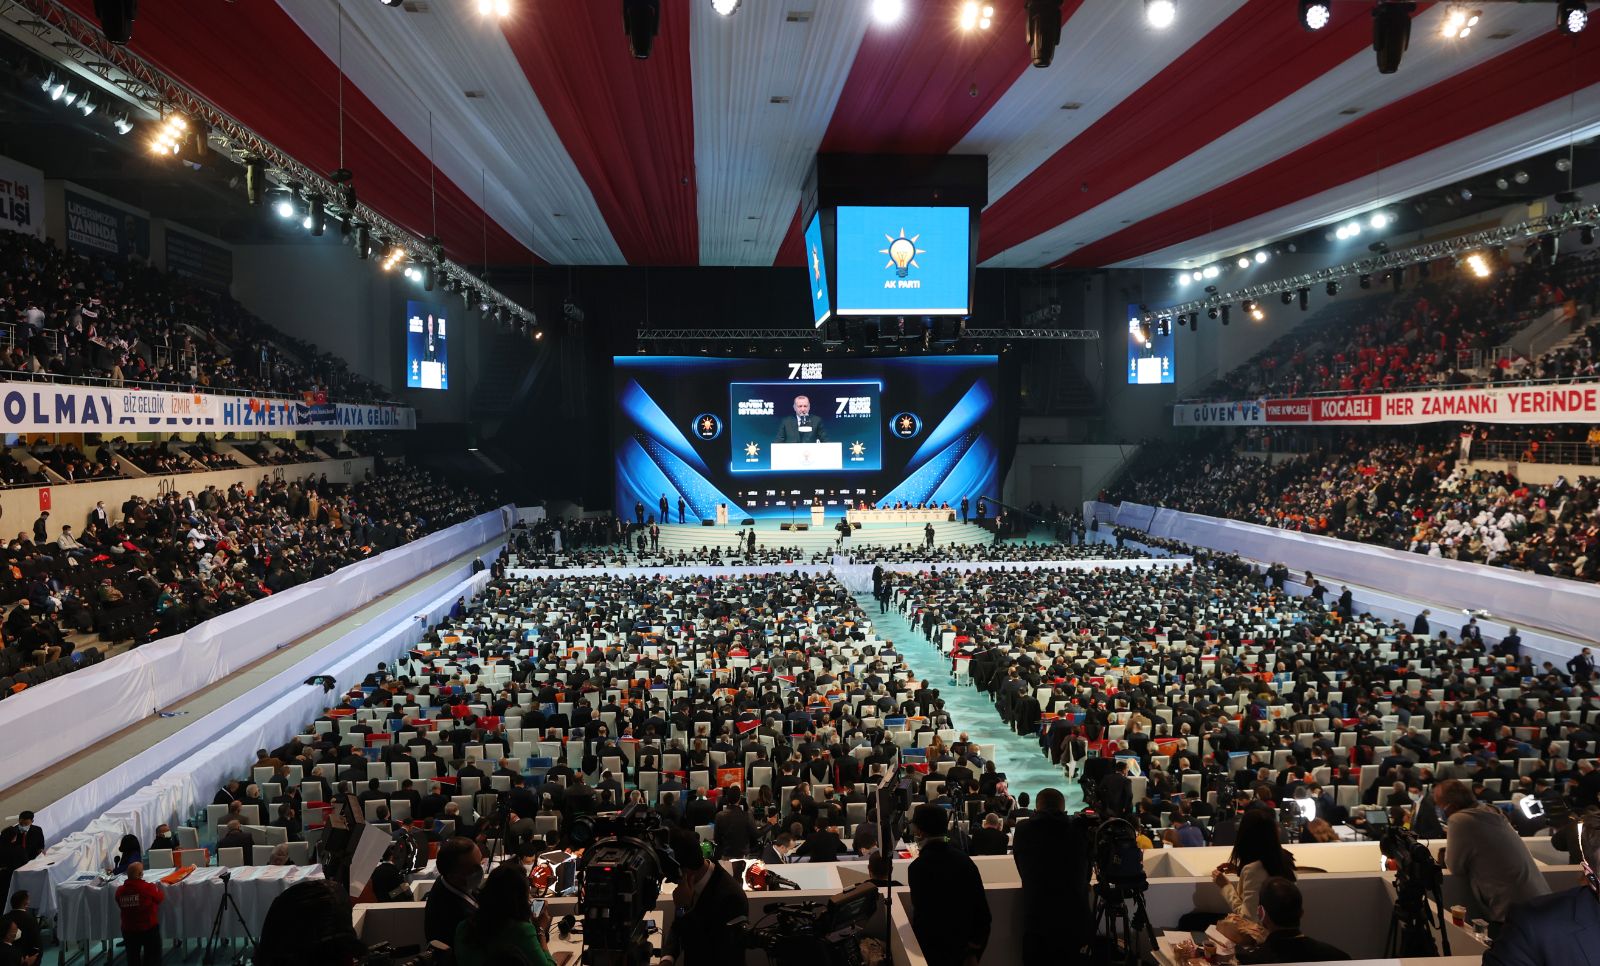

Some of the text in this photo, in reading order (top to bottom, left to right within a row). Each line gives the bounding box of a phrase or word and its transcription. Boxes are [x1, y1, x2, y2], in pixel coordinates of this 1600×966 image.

[69, 213, 118, 243] YANINDA
[4, 391, 135, 425] OLMAY
[124, 392, 191, 414] BİZ GELDİK İZMİR
[1194, 404, 1235, 421] GÜVEN
[1321, 398, 1372, 418] KOCAELİ
[1386, 398, 1414, 416] HER
[1507, 389, 1597, 413] YERİNDE
